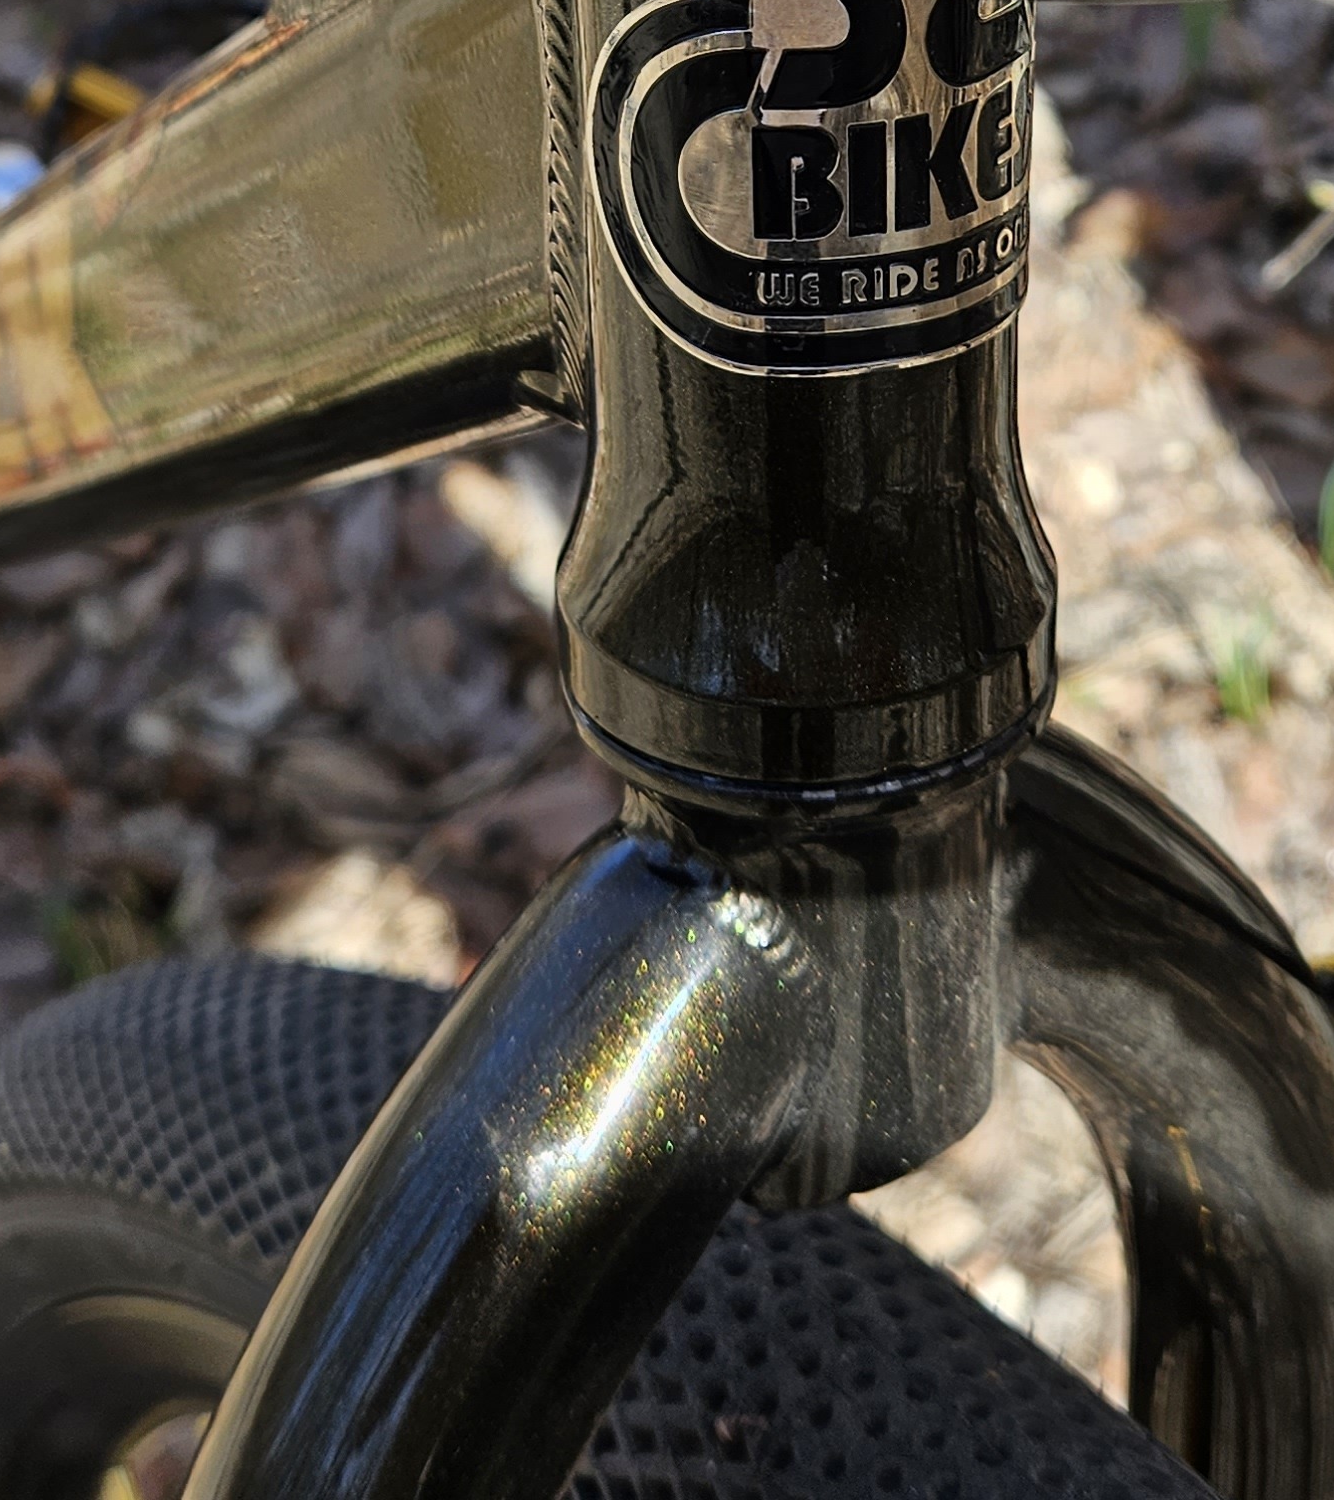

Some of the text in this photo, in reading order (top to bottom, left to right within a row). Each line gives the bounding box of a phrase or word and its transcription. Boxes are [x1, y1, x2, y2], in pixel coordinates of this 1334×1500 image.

[755, 271, 819, 305] WE
[841, 257, 939, 304] RIDE
[955, 239, 987, 283] AS
